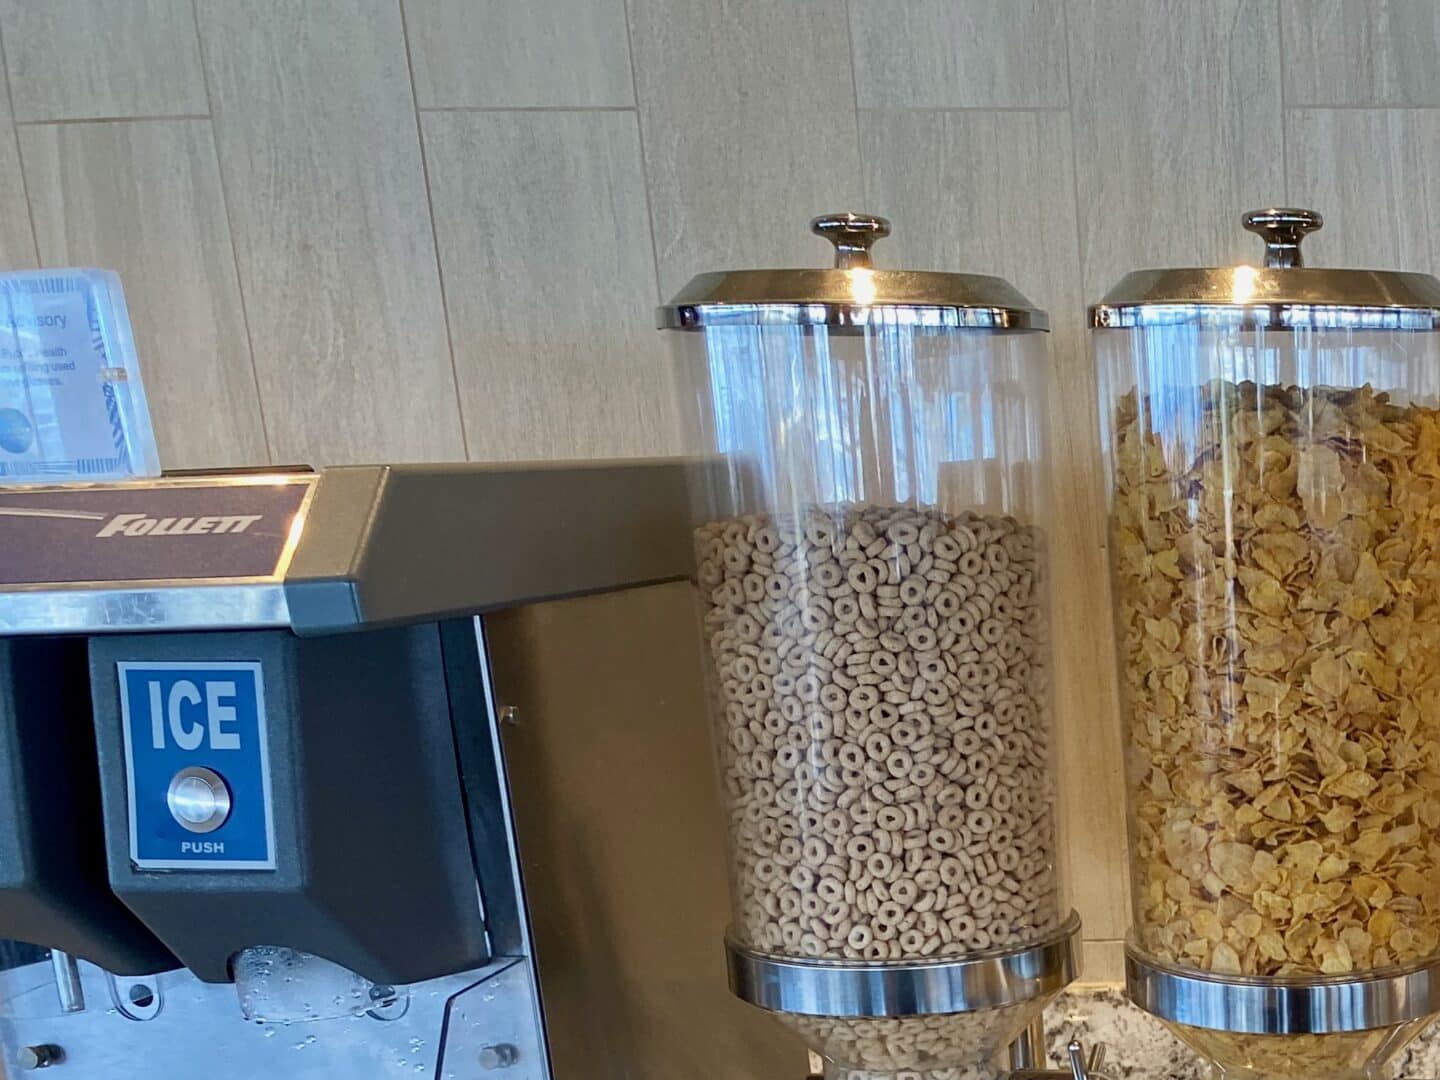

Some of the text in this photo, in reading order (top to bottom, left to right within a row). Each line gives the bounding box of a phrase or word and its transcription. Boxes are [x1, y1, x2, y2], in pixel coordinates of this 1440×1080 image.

[97, 513, 262, 538] FOLLETT
[148, 680, 241, 750] ICE
[181, 842, 225, 853] PUSH
